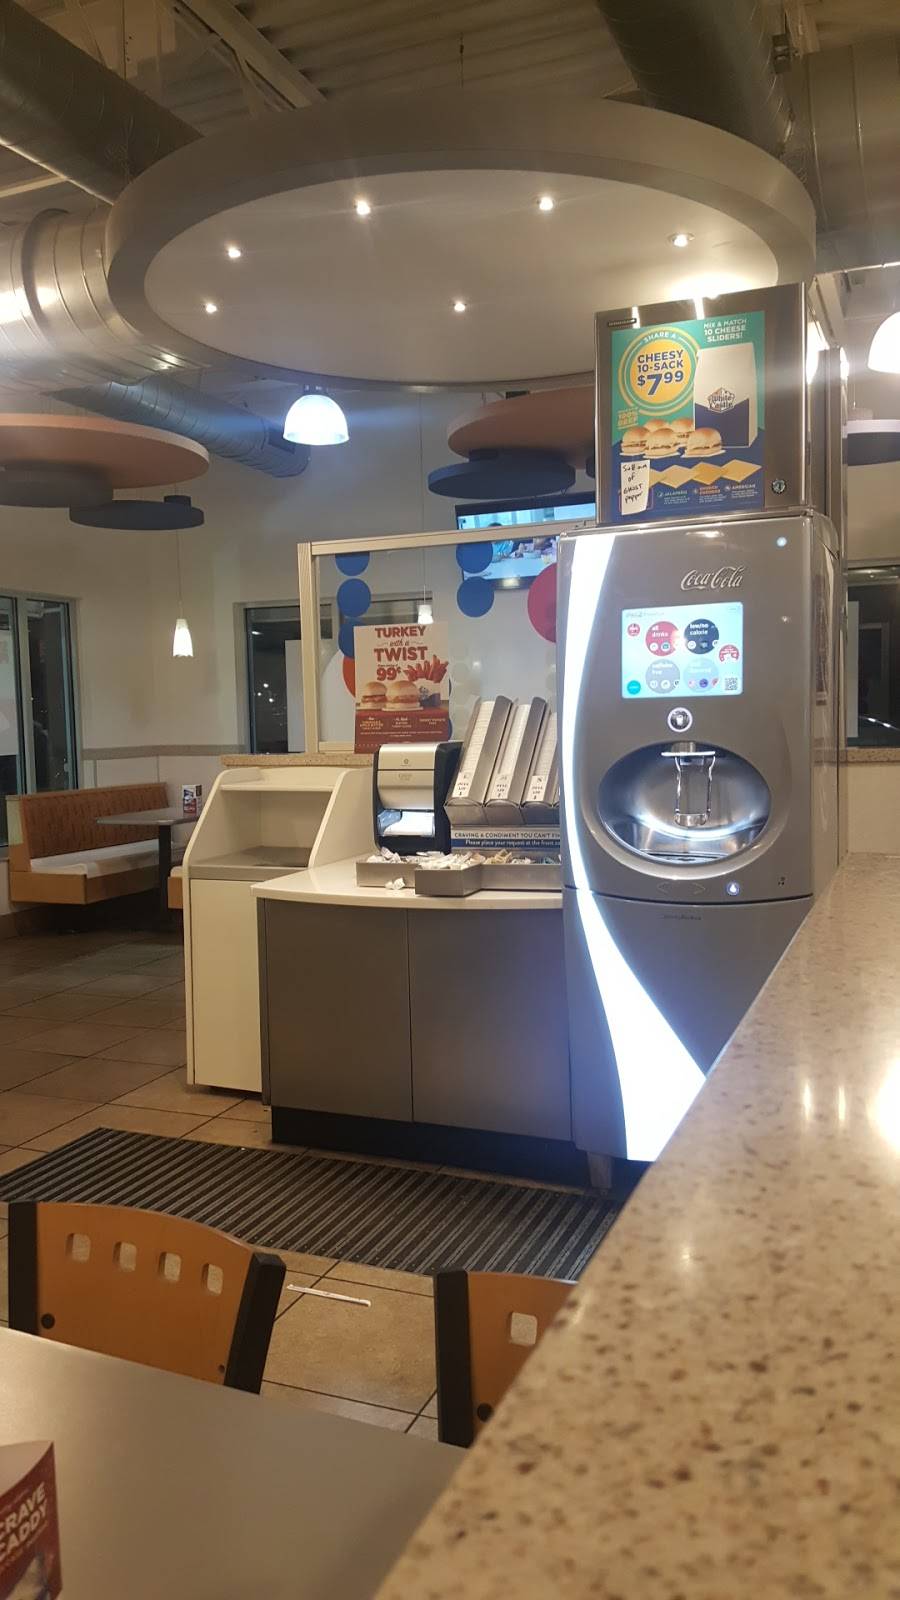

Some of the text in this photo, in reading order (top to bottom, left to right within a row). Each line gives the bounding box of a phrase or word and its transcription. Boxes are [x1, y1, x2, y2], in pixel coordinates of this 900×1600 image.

[724, 318, 747, 326] MATCH
[714, 325, 746, 335] CHEESE
[643, 331, 677, 343] SHARE A
[706, 332, 743, 343] SLIDERS!
[637, 349, 684, 364] CHEESY
[637, 359, 684, 373] 10-SACK
[680, 565, 745, 591] Coca-Cola
[375, 625, 426, 638] TURKEY
[389, 638, 404, 647] with
[374, 646, 428, 662] TWIST
[376, 666, 402, 681] 99¢
[481, 839, 494, 847] place
